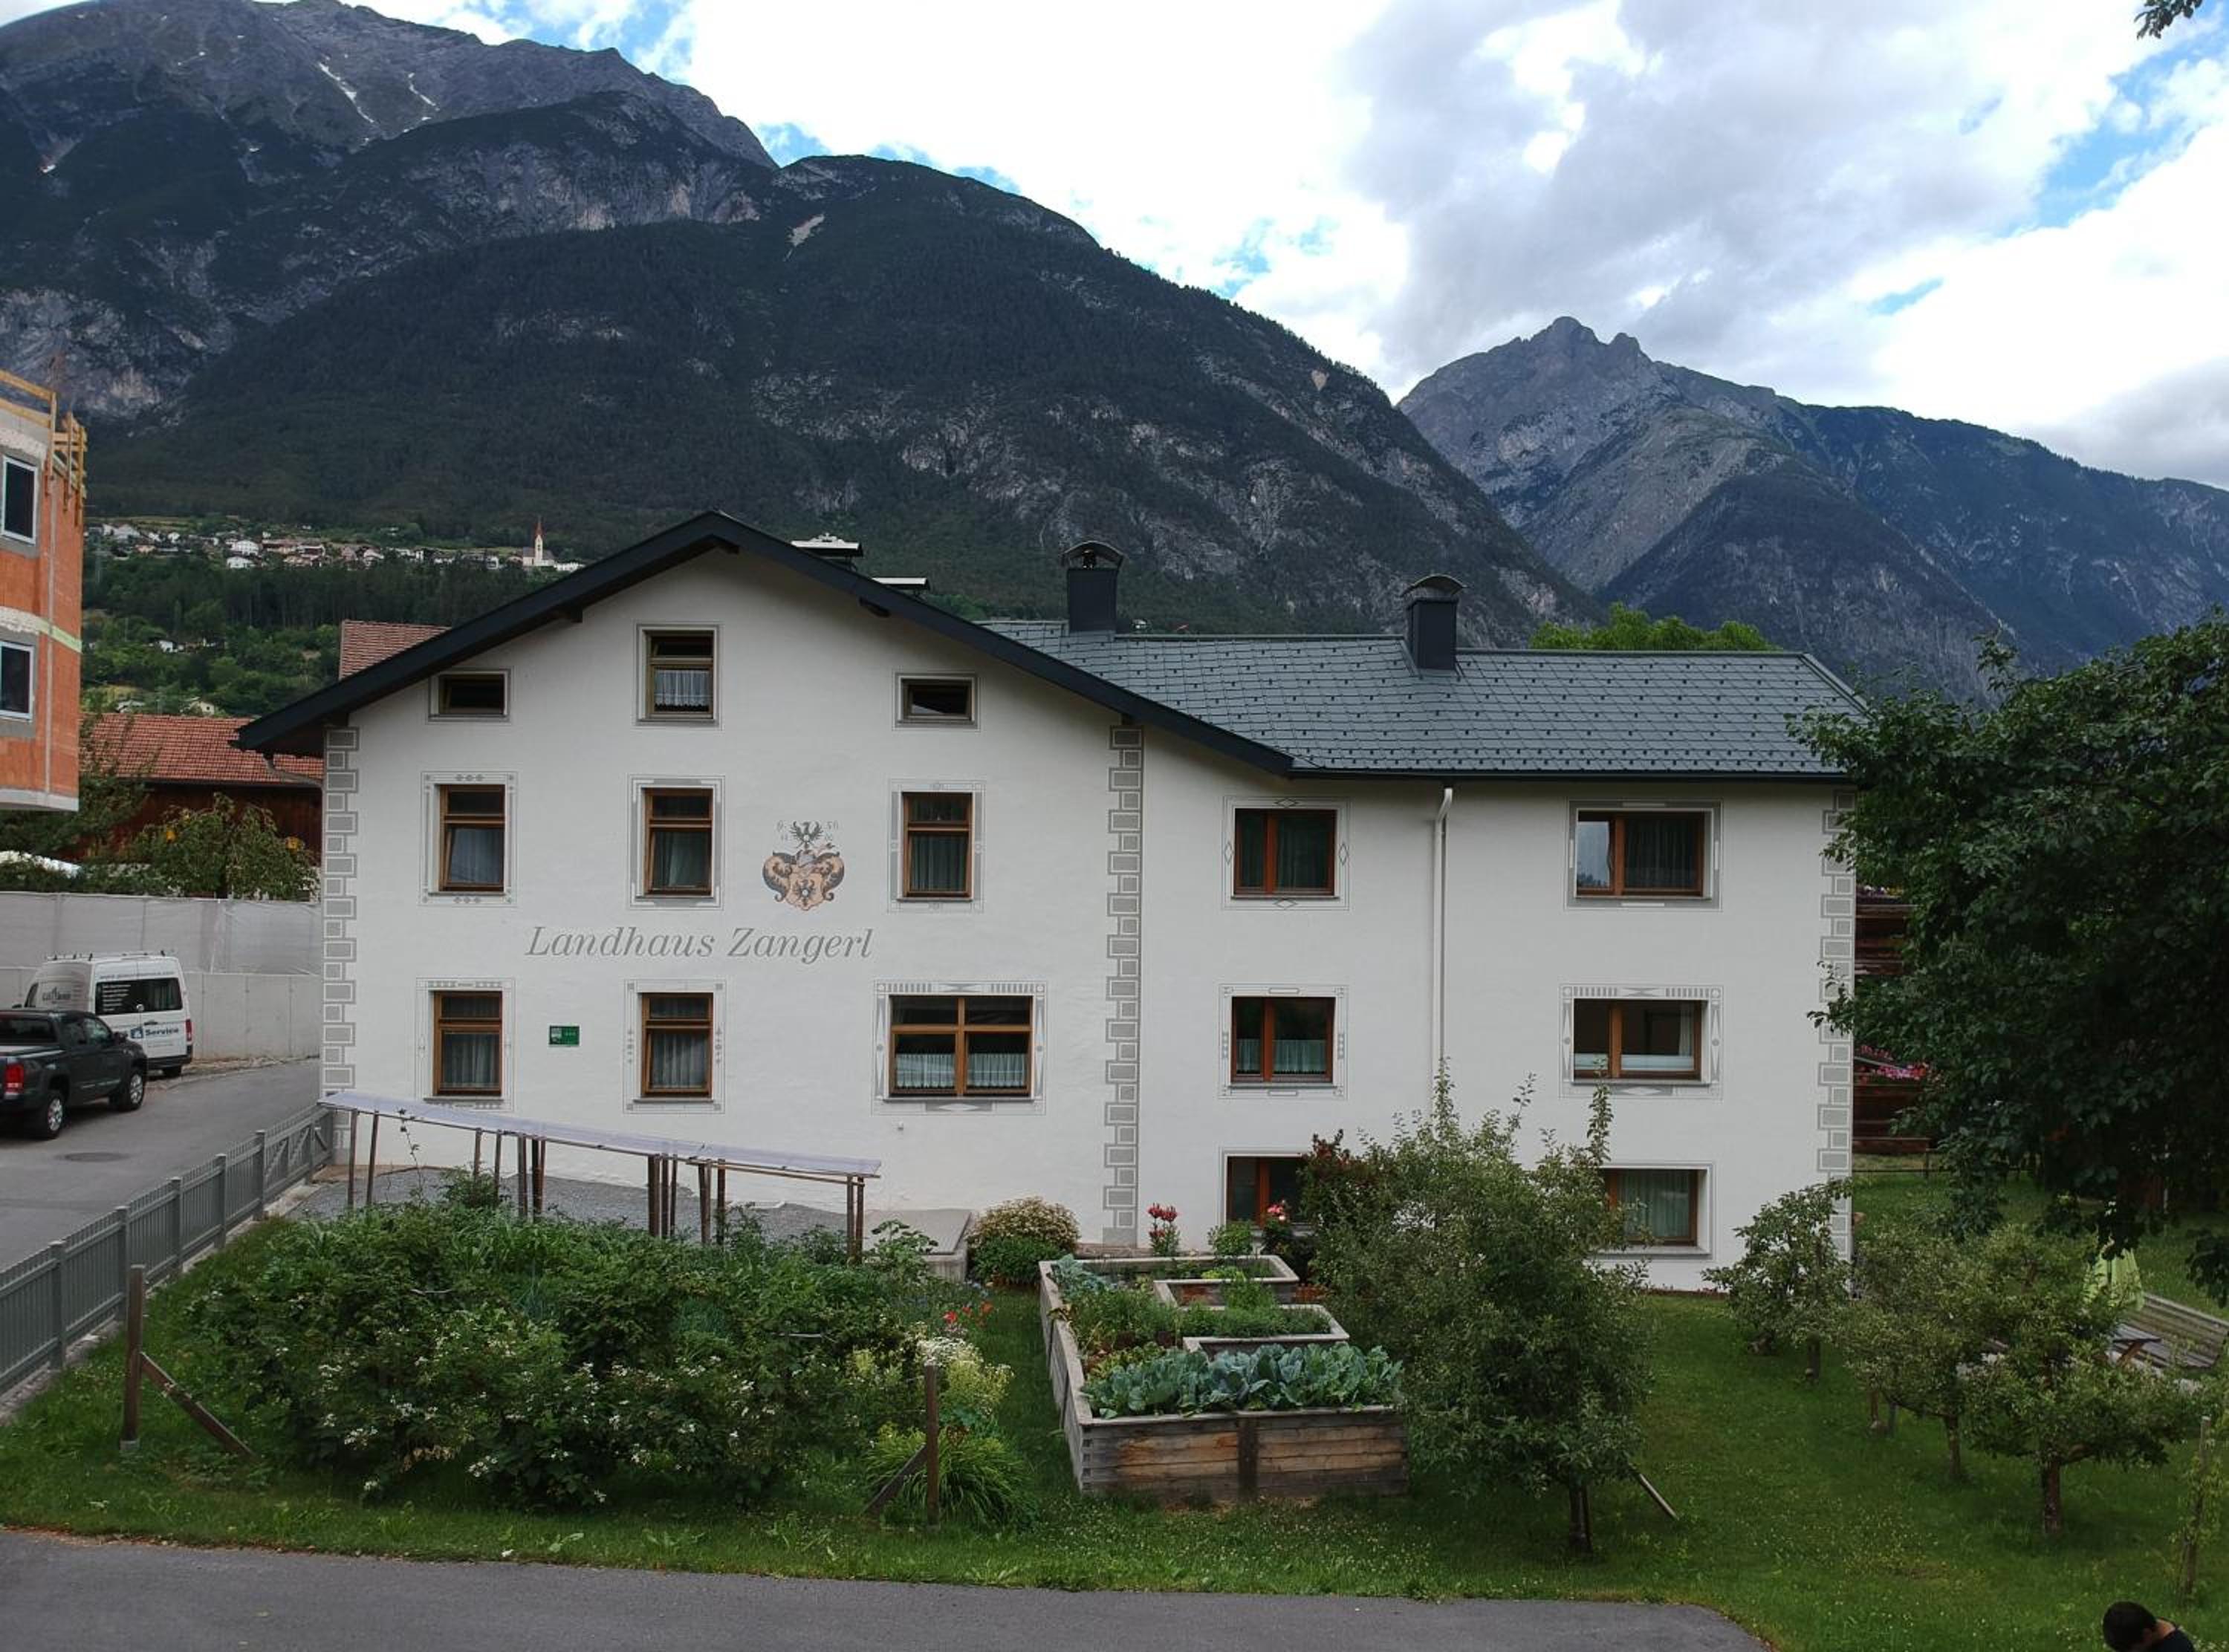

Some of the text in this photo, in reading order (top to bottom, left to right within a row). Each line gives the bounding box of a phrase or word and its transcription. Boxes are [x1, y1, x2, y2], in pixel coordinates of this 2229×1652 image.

[525, 926, 874, 964] Landhaus Zangerl
[145, 1027, 179, 1036] Service
